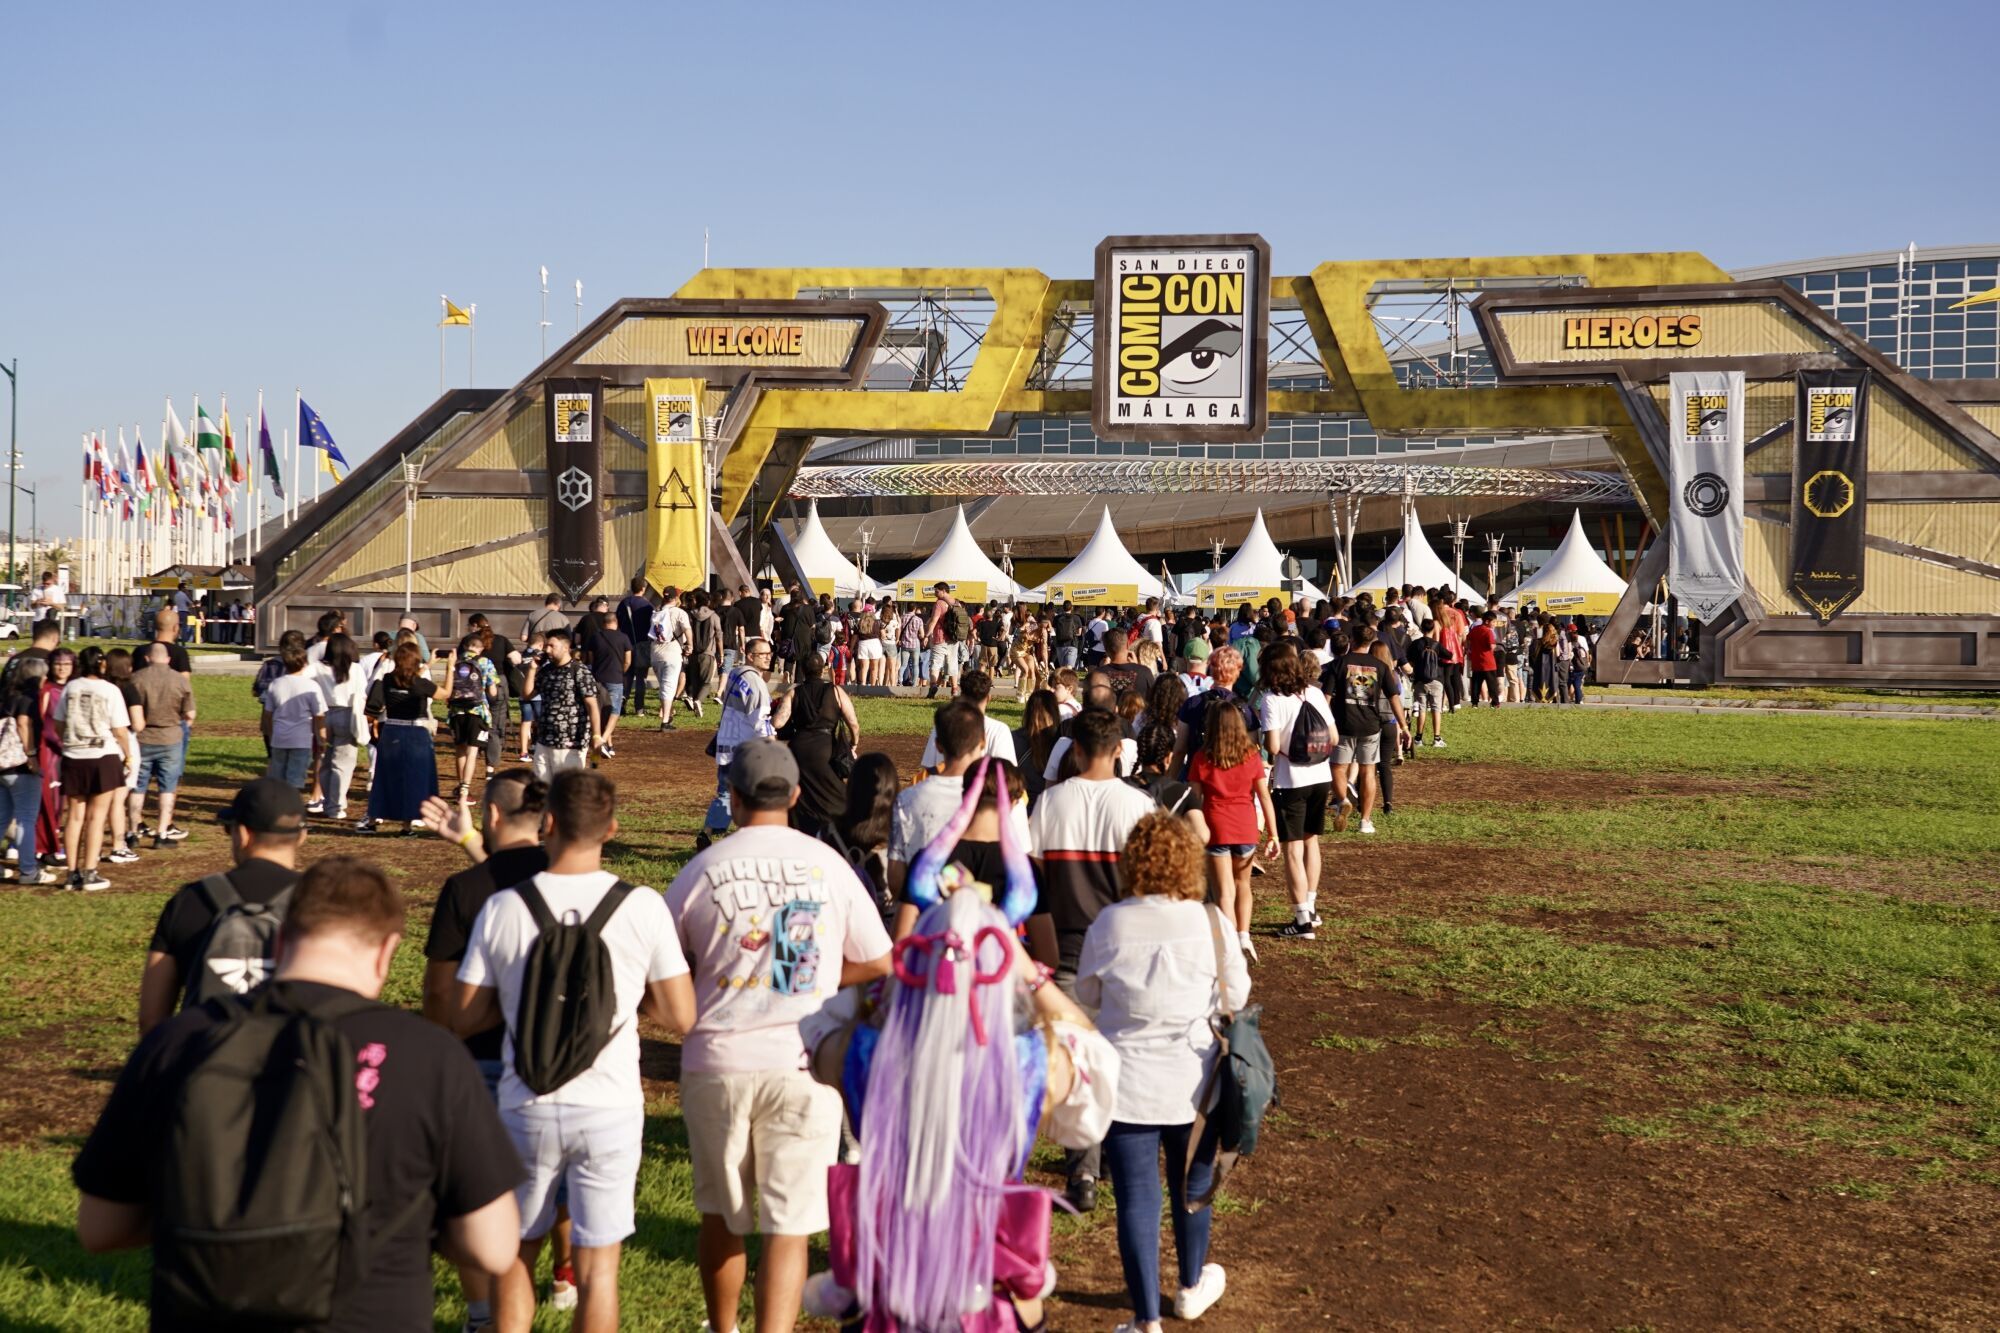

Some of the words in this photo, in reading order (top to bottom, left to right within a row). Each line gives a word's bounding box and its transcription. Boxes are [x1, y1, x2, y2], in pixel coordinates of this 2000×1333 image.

[1119, 259, 1159, 271] SAN
[1177, 258, 1245, 270] DIEGO
[1164, 274, 1243, 314] CON
[687, 325, 803, 356] WELCOME
[1119, 275, 1162, 397] COMIC
[1565, 315, 1703, 349] HEROES
[558, 400, 570, 434] COMIC
[569, 400, 588, 411] CON
[670, 401, 691, 412] CON
[1118, 400, 1240, 418] MÁLAGA
[1687, 397, 1700, 435] COMIC
[1701, 396, 1727, 409] CON
[1811, 395, 1825, 432] COMIC
[1825, 394, 1852, 407] CON
[658, 401, 670, 435] COMIC
[711, 882, 759, 923] TO
